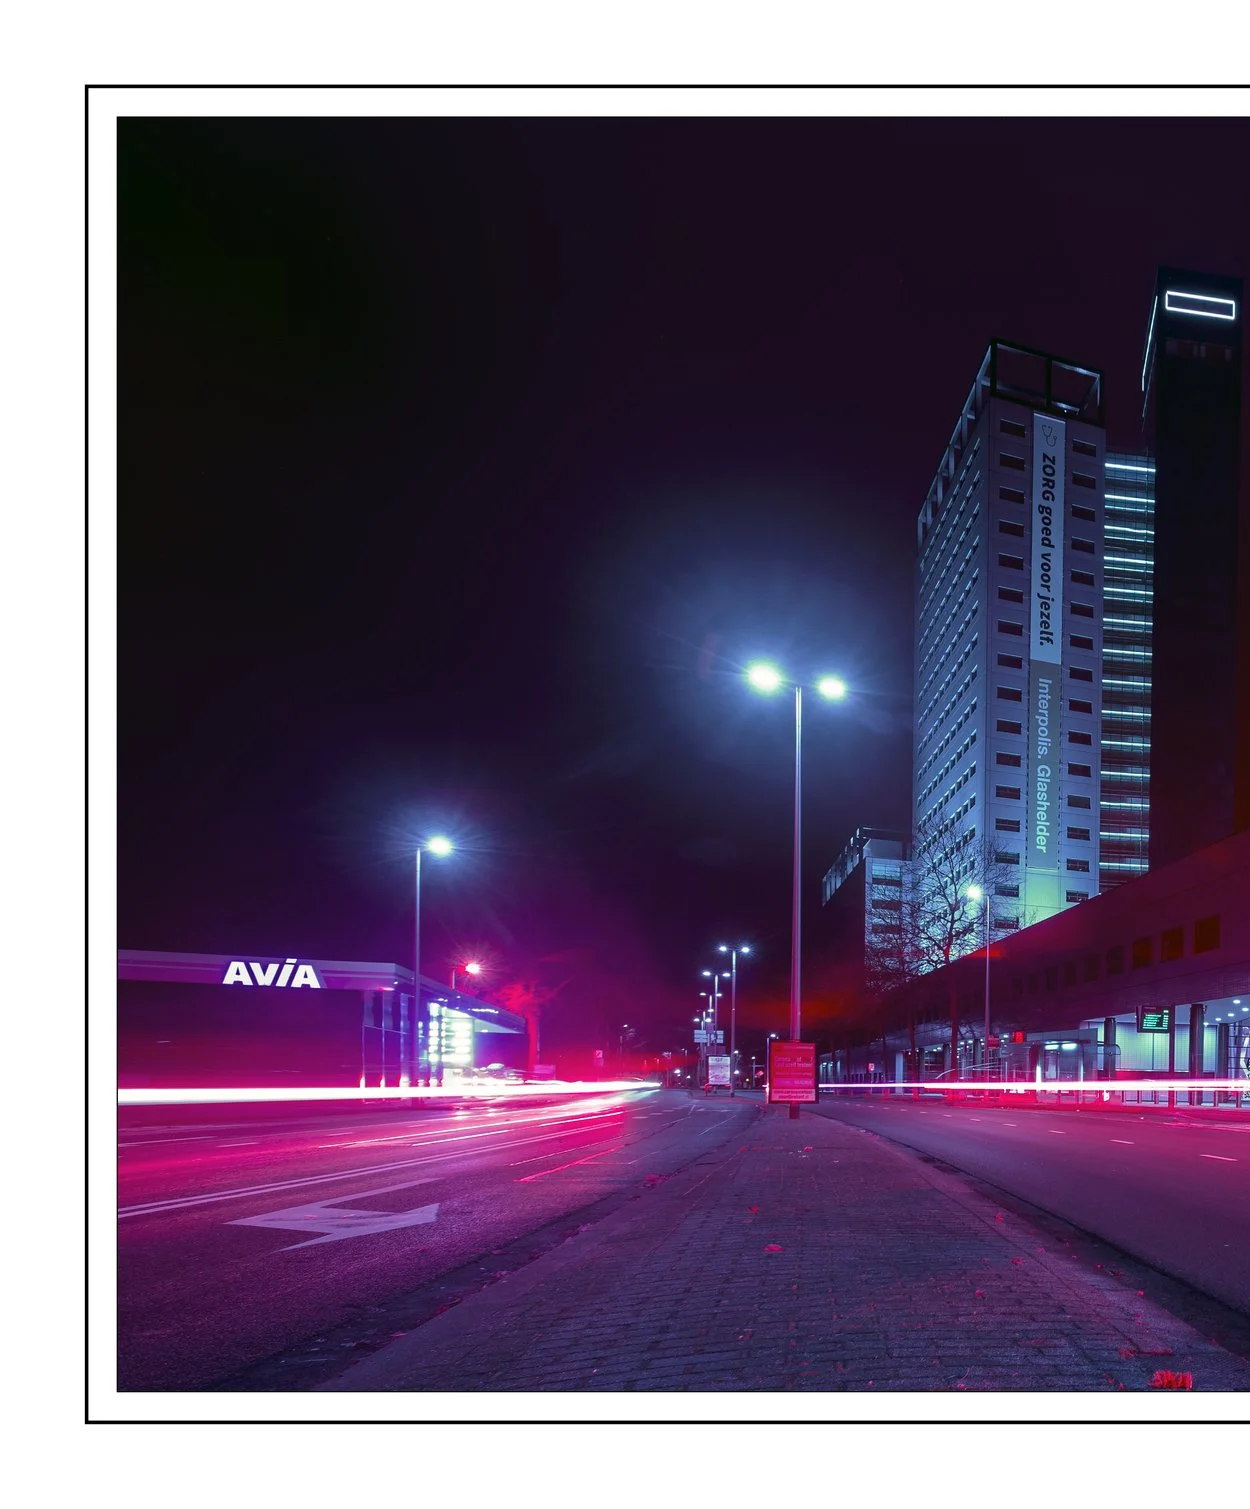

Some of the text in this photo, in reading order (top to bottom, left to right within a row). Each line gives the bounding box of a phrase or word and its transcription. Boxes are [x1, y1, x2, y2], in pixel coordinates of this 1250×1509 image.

[1037, 453, 1056, 646] ZORG goed voor jezelf.
[1035, 678, 1052, 853] Interpolis. Glashelder
